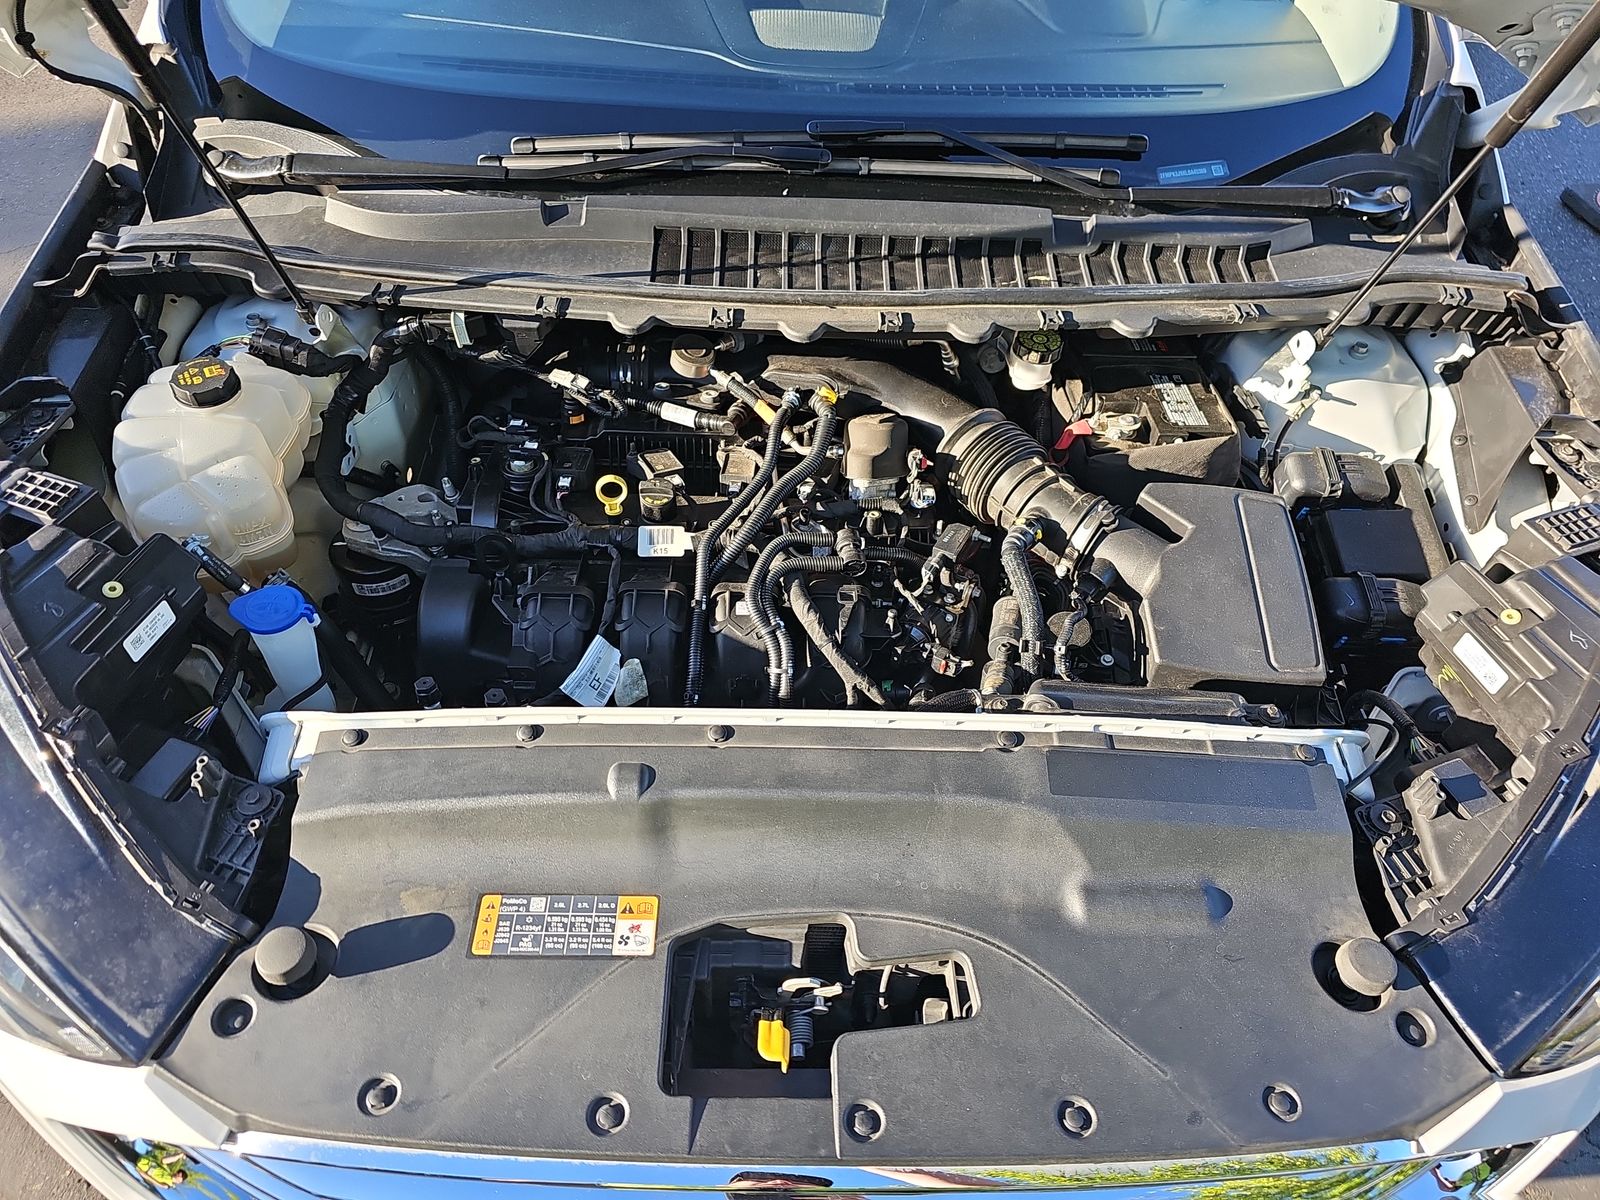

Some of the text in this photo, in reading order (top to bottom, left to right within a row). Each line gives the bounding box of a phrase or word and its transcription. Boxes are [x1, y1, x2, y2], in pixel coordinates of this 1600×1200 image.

[653, 547, 669, 555] K15
[588, 672, 602, 692] EF
[500, 905, 526, 913] (GWP 4)
[515, 924, 542, 932] R-1234yf
